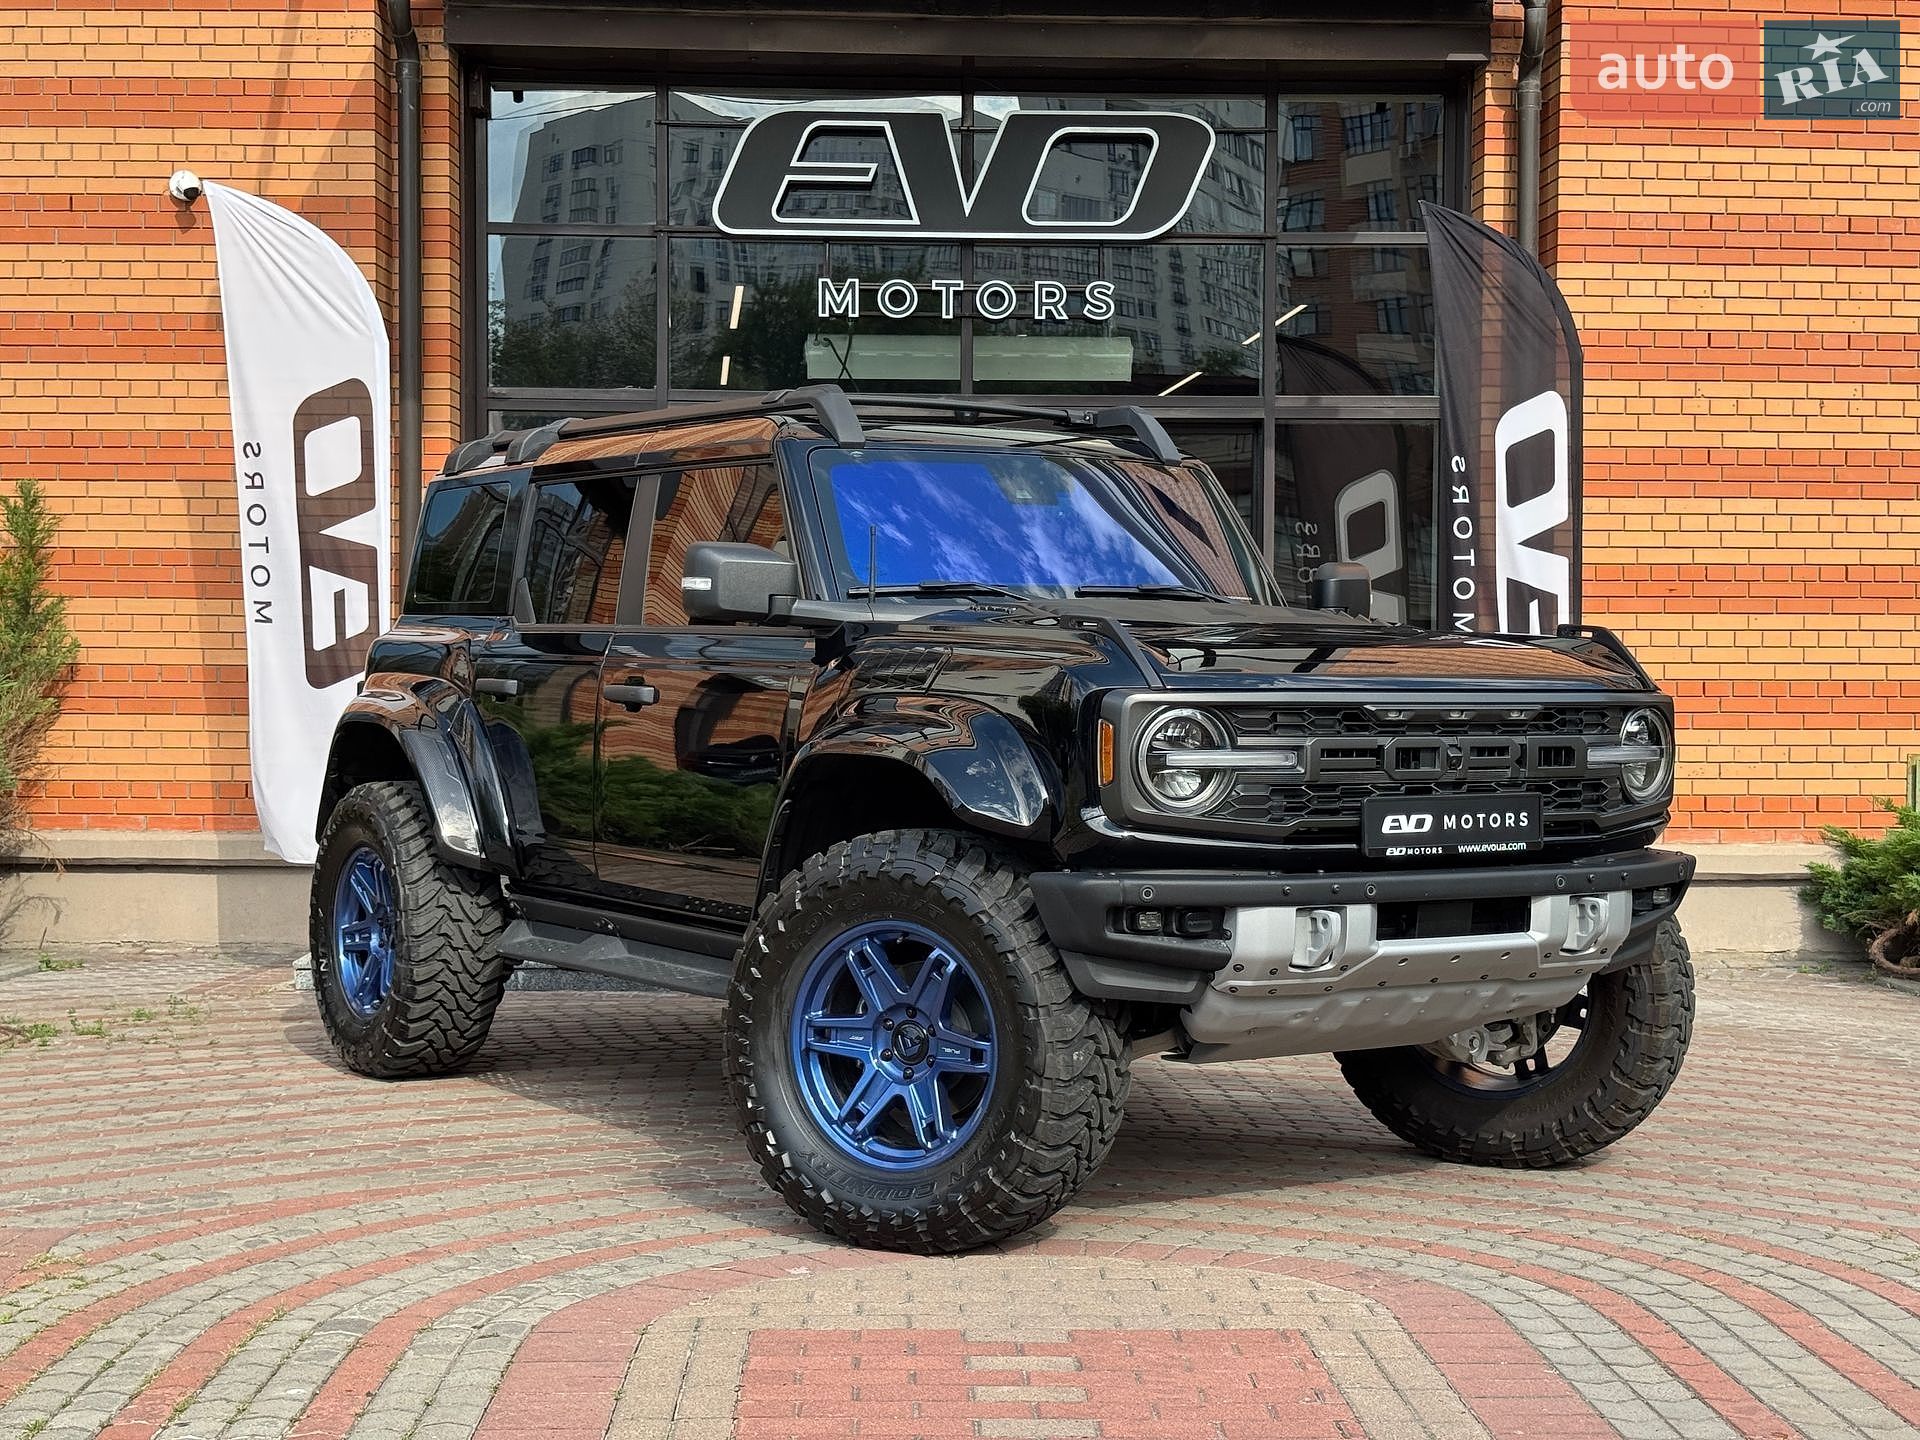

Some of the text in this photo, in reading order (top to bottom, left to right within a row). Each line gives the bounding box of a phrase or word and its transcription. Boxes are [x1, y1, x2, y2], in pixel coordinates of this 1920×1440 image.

[712, 110, 1216, 240] EVO
[818, 278, 1116, 321] MOTORS
[1304, 735, 1588, 783] FORD
[1381, 812, 1529, 834] EVO MOTORS
[1385, 842, 1527, 856] EVO MOTORS www.evoua.com
